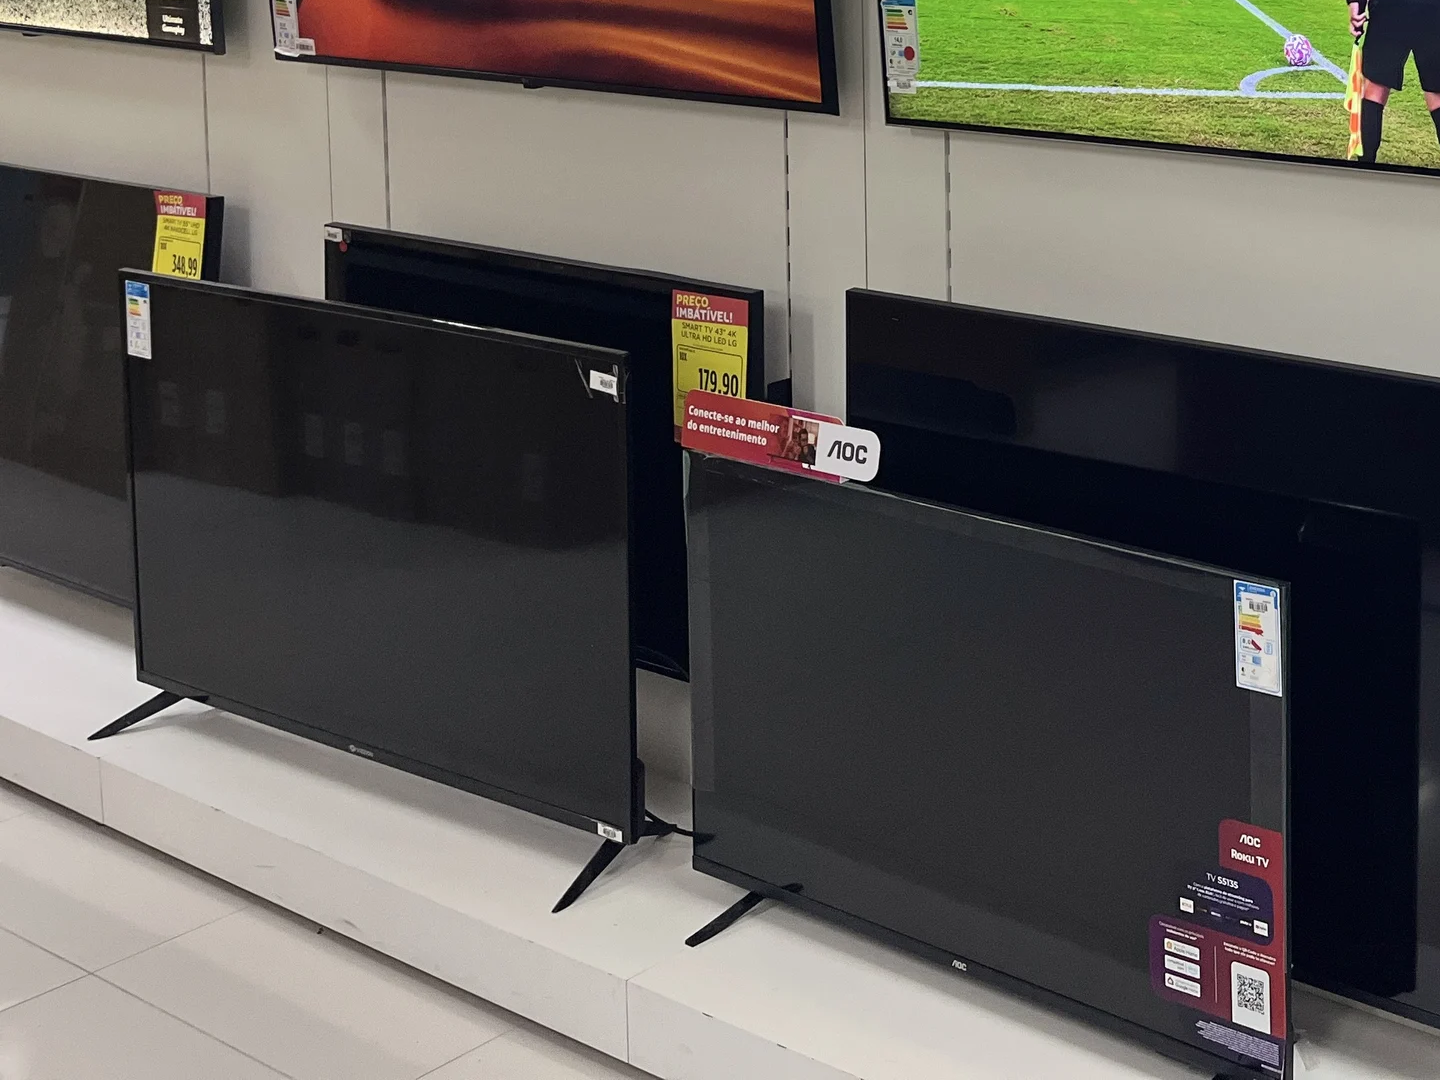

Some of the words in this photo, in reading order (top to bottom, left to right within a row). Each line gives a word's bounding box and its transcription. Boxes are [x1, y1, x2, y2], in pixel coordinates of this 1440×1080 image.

[159, 195, 183, 205] PREÇO
[172, 254, 197, 278] 348,99
[676, 294, 709, 311] PREÇO
[676, 307, 733, 323] IMBATÍVEL!
[682, 322, 703, 333] SMART
[705, 326, 714, 334] TV
[728, 330, 737, 338] 4K
[681, 331, 701, 342] ULTRA
[703, 335, 712, 343] HD
[714, 337, 727, 346] LED
[688, 405, 734, 424] Conecte-se
[736, 417, 747, 427] ao
[748, 418, 780, 434] melhor
[687, 421, 698, 432] do
[698, 424, 768, 446] entretenimento
[827, 440, 868, 464] AOC
[1239, 834, 1261, 849] AOC
[1254, 855, 1270, 869] TV
[1206, 872, 1217, 883] TV
[952, 960, 967, 971] AOC
